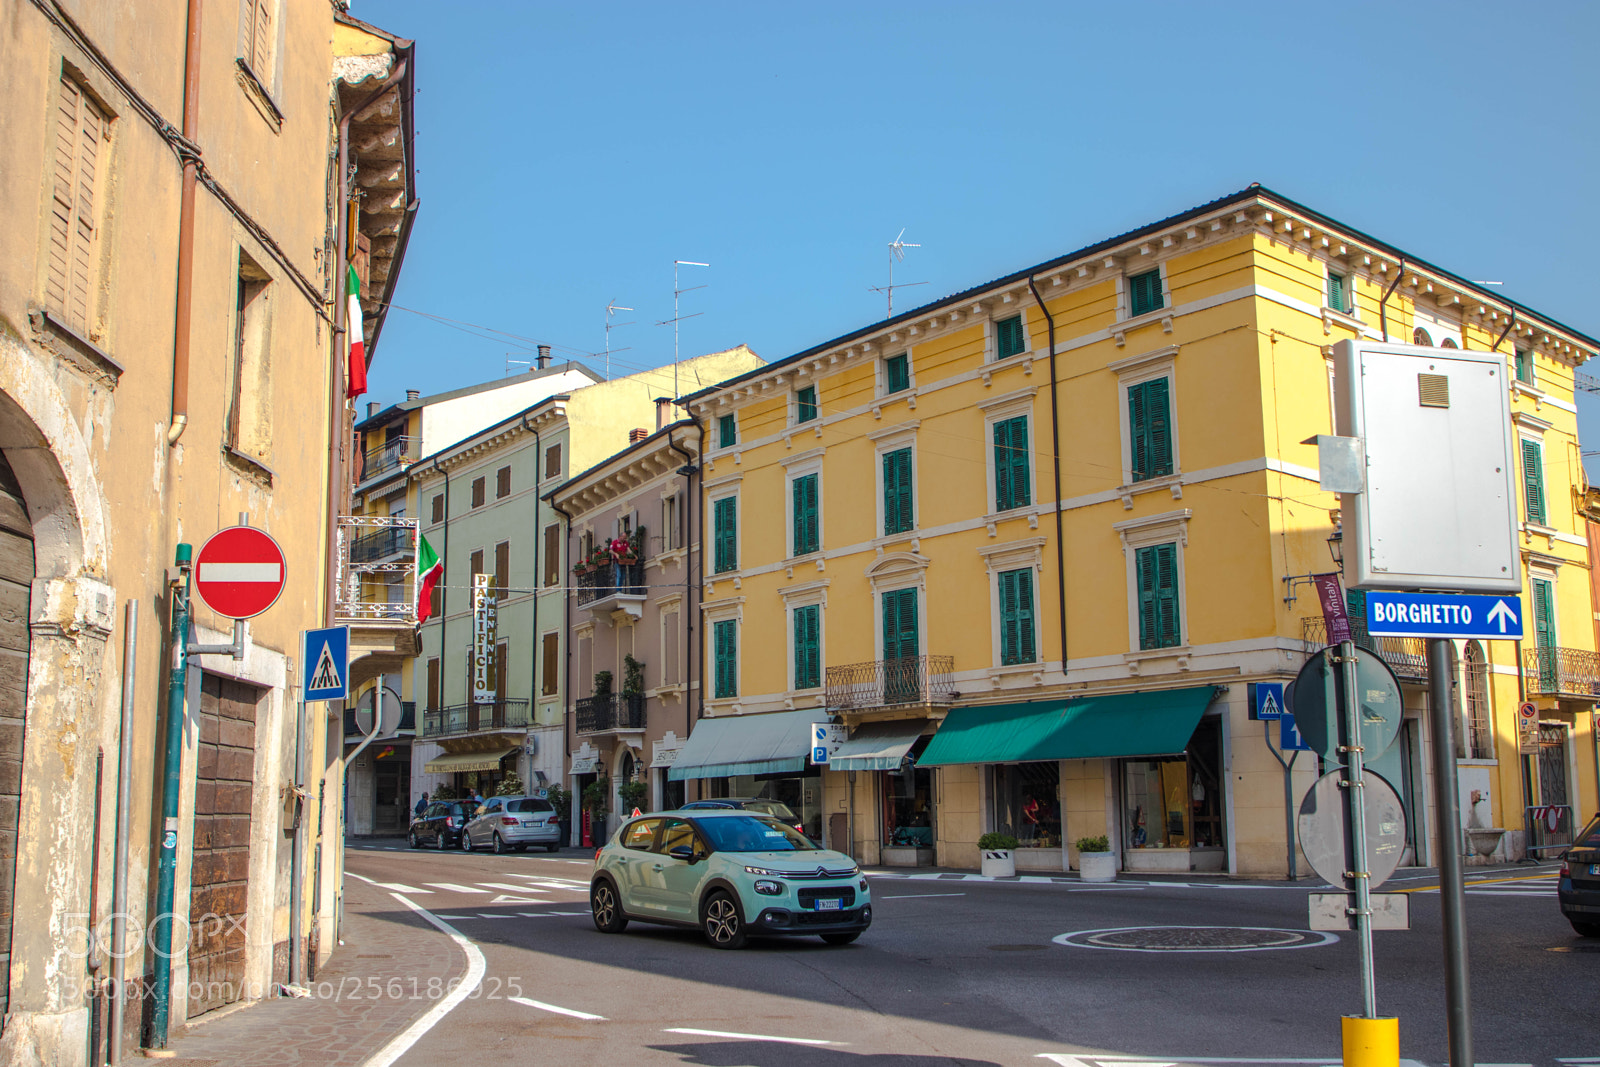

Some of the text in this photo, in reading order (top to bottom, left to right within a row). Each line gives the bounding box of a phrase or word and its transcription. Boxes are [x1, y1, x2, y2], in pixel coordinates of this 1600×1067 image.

[1325, 580, 1341, 617] vinitaly
[1374, 602, 1473, 625] BORGHETTO
[476, 575, 486, 690] PASTIFICIO
[487, 596, 496, 664] MENINI
